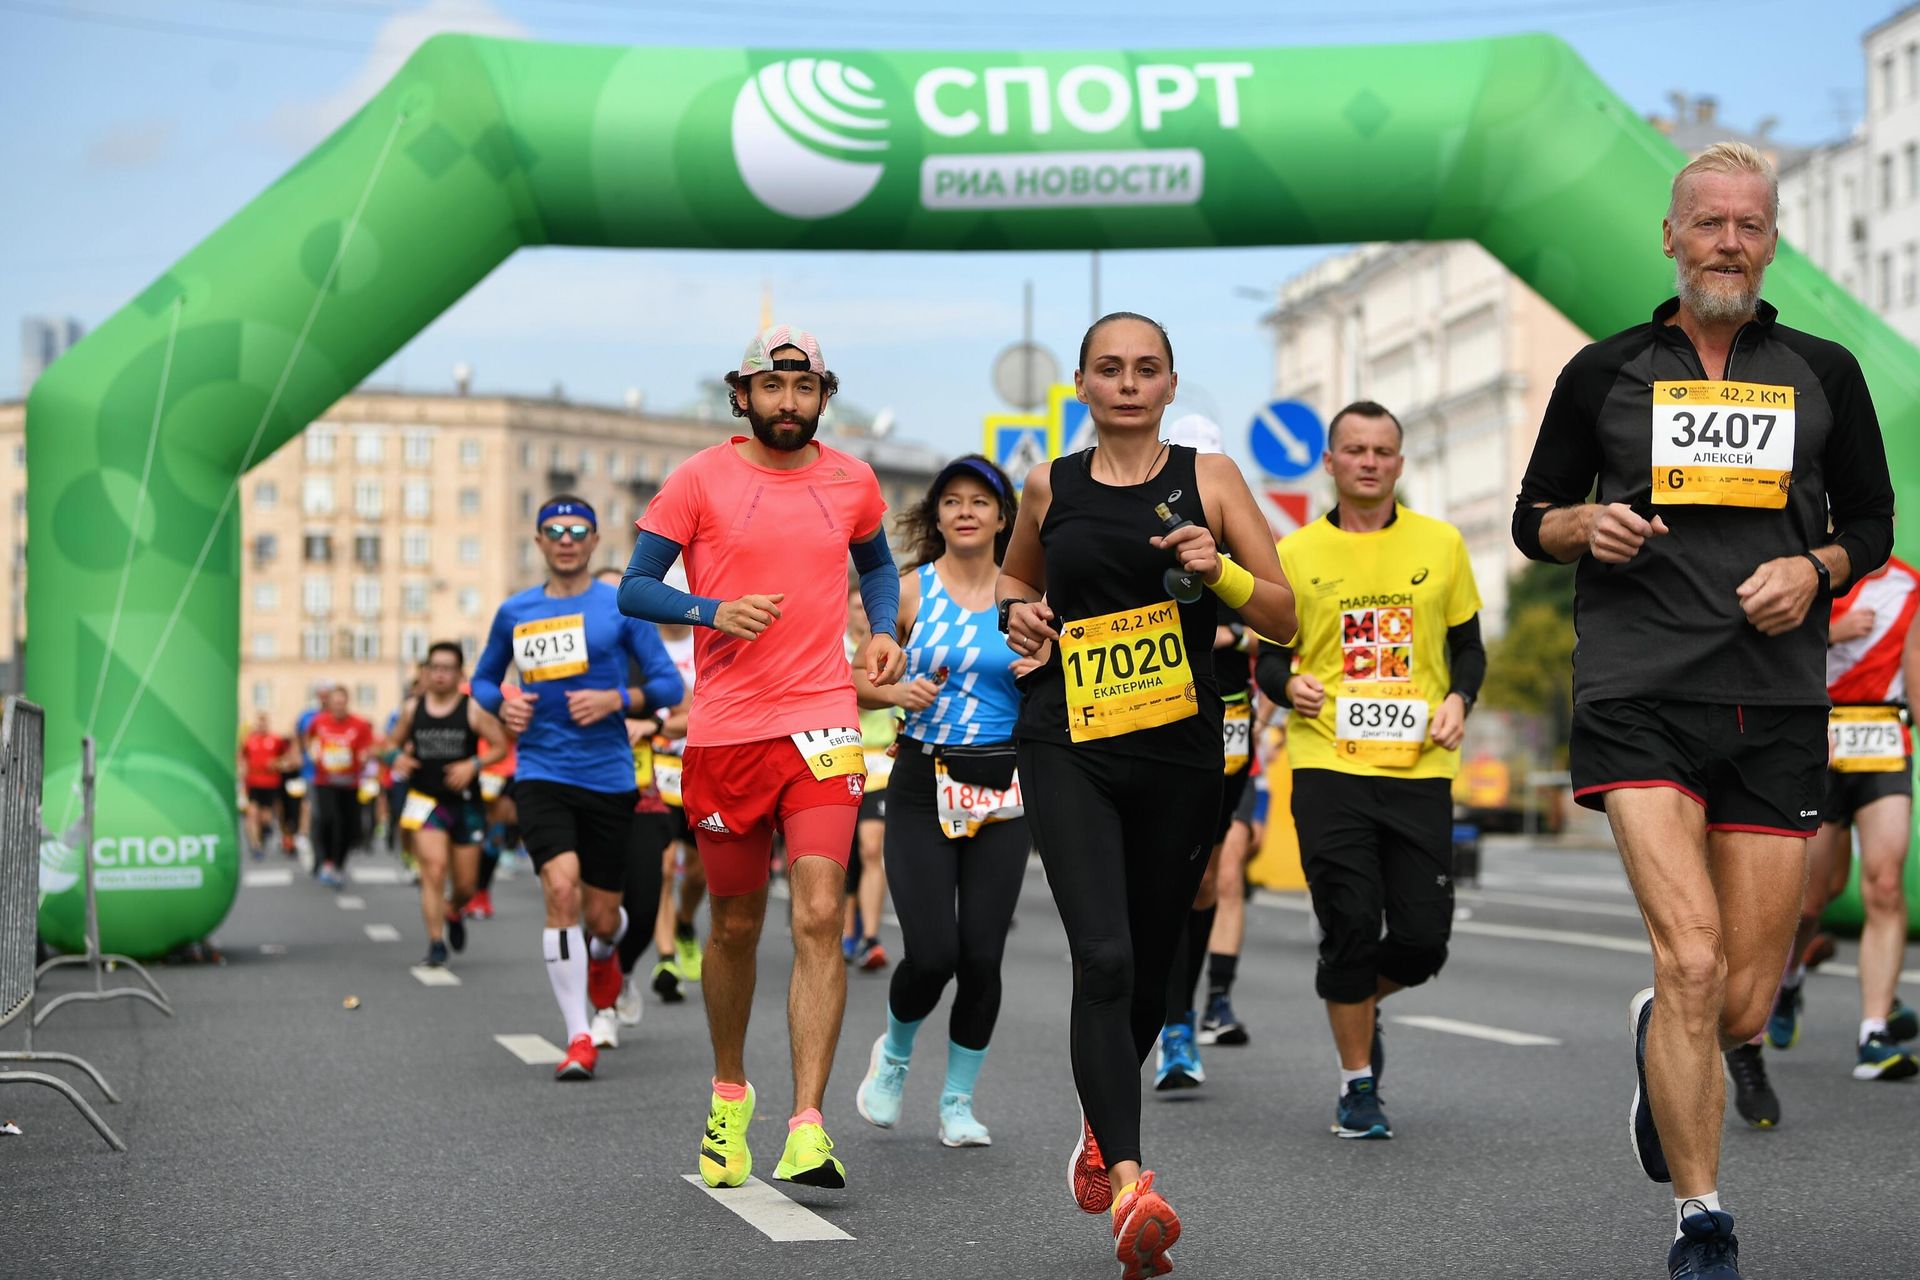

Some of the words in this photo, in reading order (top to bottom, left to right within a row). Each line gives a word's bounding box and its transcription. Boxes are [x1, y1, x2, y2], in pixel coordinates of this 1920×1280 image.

[914, 61, 1254, 137] СПОРТ
[934, 168, 1005, 199] РИА
[1014, 162, 1191, 197] НОВОСТИ
[1720, 387, 1755, 403] 42,2
[1761, 391, 1787, 404] КМ
[1671, 411, 1777, 450] 3407
[1693, 452, 1754, 465] АЛЕКСЕЙ
[1668, 468, 1684, 489] G
[1340, 594, 1413, 609] МАРАФОН
[1111, 614, 1144, 633] 42,2
[1147, 607, 1173, 625] КМ
[523, 633, 574, 657] 4913
[1067, 632, 1183, 688] 17020
[1093, 676, 1164, 699] ЕКАТЕРИНА
[1082, 705, 1095, 726] F
[1349, 703, 1415, 728] 8396
[1346, 741, 1357, 754] G
[819, 753, 834, 768] G
[697, 822, 730, 833] adidas
[953, 820, 963, 832] F
[93, 834, 220, 865] СПОРТ
